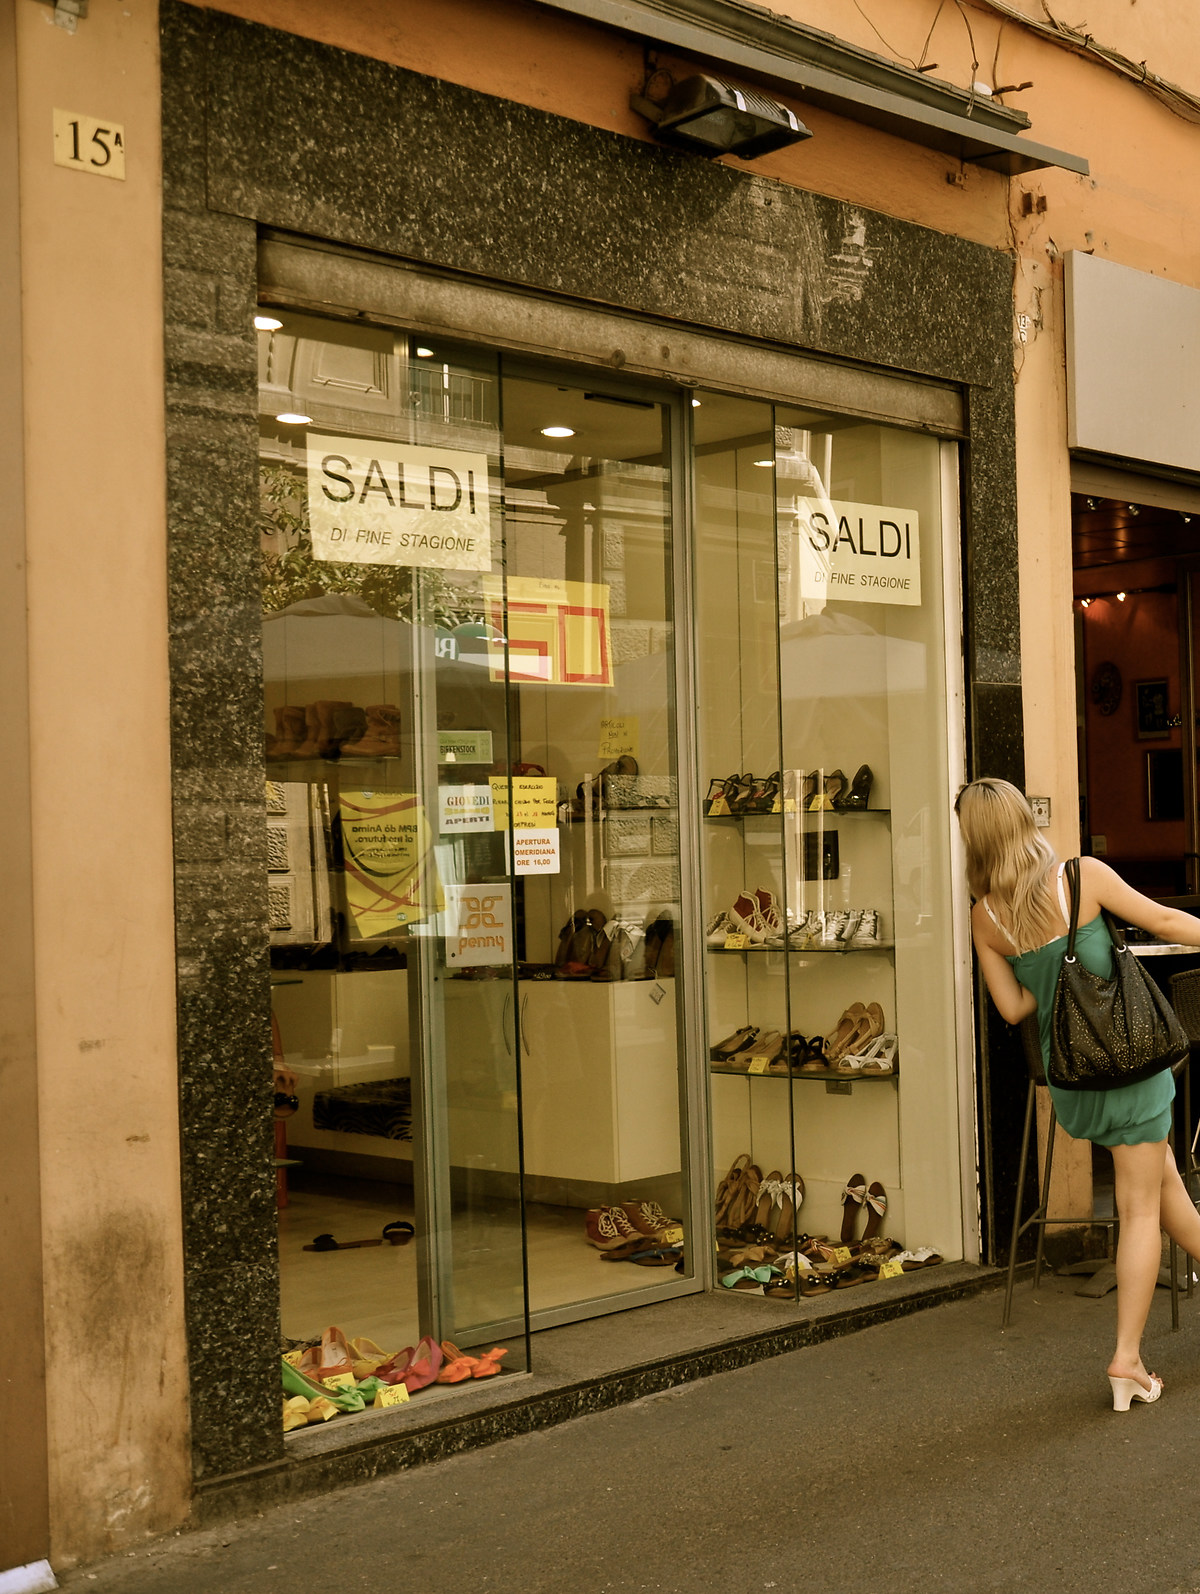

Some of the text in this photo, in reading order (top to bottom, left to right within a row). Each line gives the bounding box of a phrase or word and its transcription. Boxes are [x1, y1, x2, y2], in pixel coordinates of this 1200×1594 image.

[321, 454, 477, 515] SALDI
[330, 527, 476, 552] DI FINE STAGIONE
[808, 511, 911, 559] SALDI
[830, 572, 855, 585] FINE
[860, 574, 911, 590] STAGIONE
[514, 848, 556, 856] OMERIDIANA
[516, 838, 551, 846] APERTURA
[459, 935, 505, 956] penny
